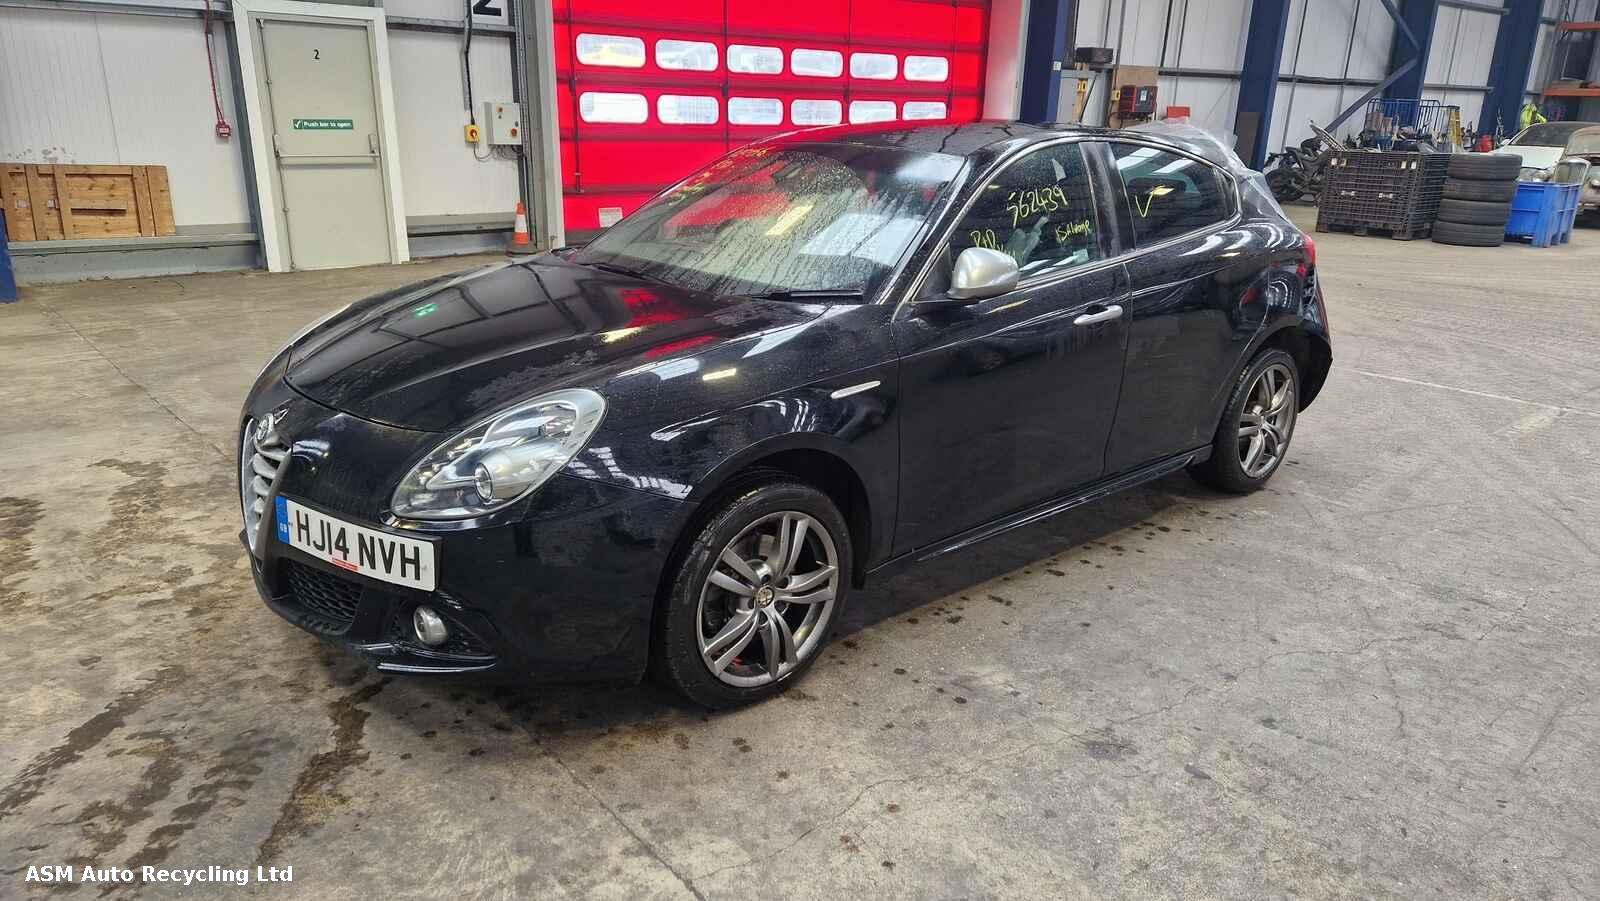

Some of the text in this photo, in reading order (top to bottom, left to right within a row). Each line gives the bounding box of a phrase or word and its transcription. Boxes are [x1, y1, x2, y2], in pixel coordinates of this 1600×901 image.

[313, 49, 320, 60] 2
[1006, 184, 1069, 230] 562439
[295, 510, 421, 581] HJ14 NVH
